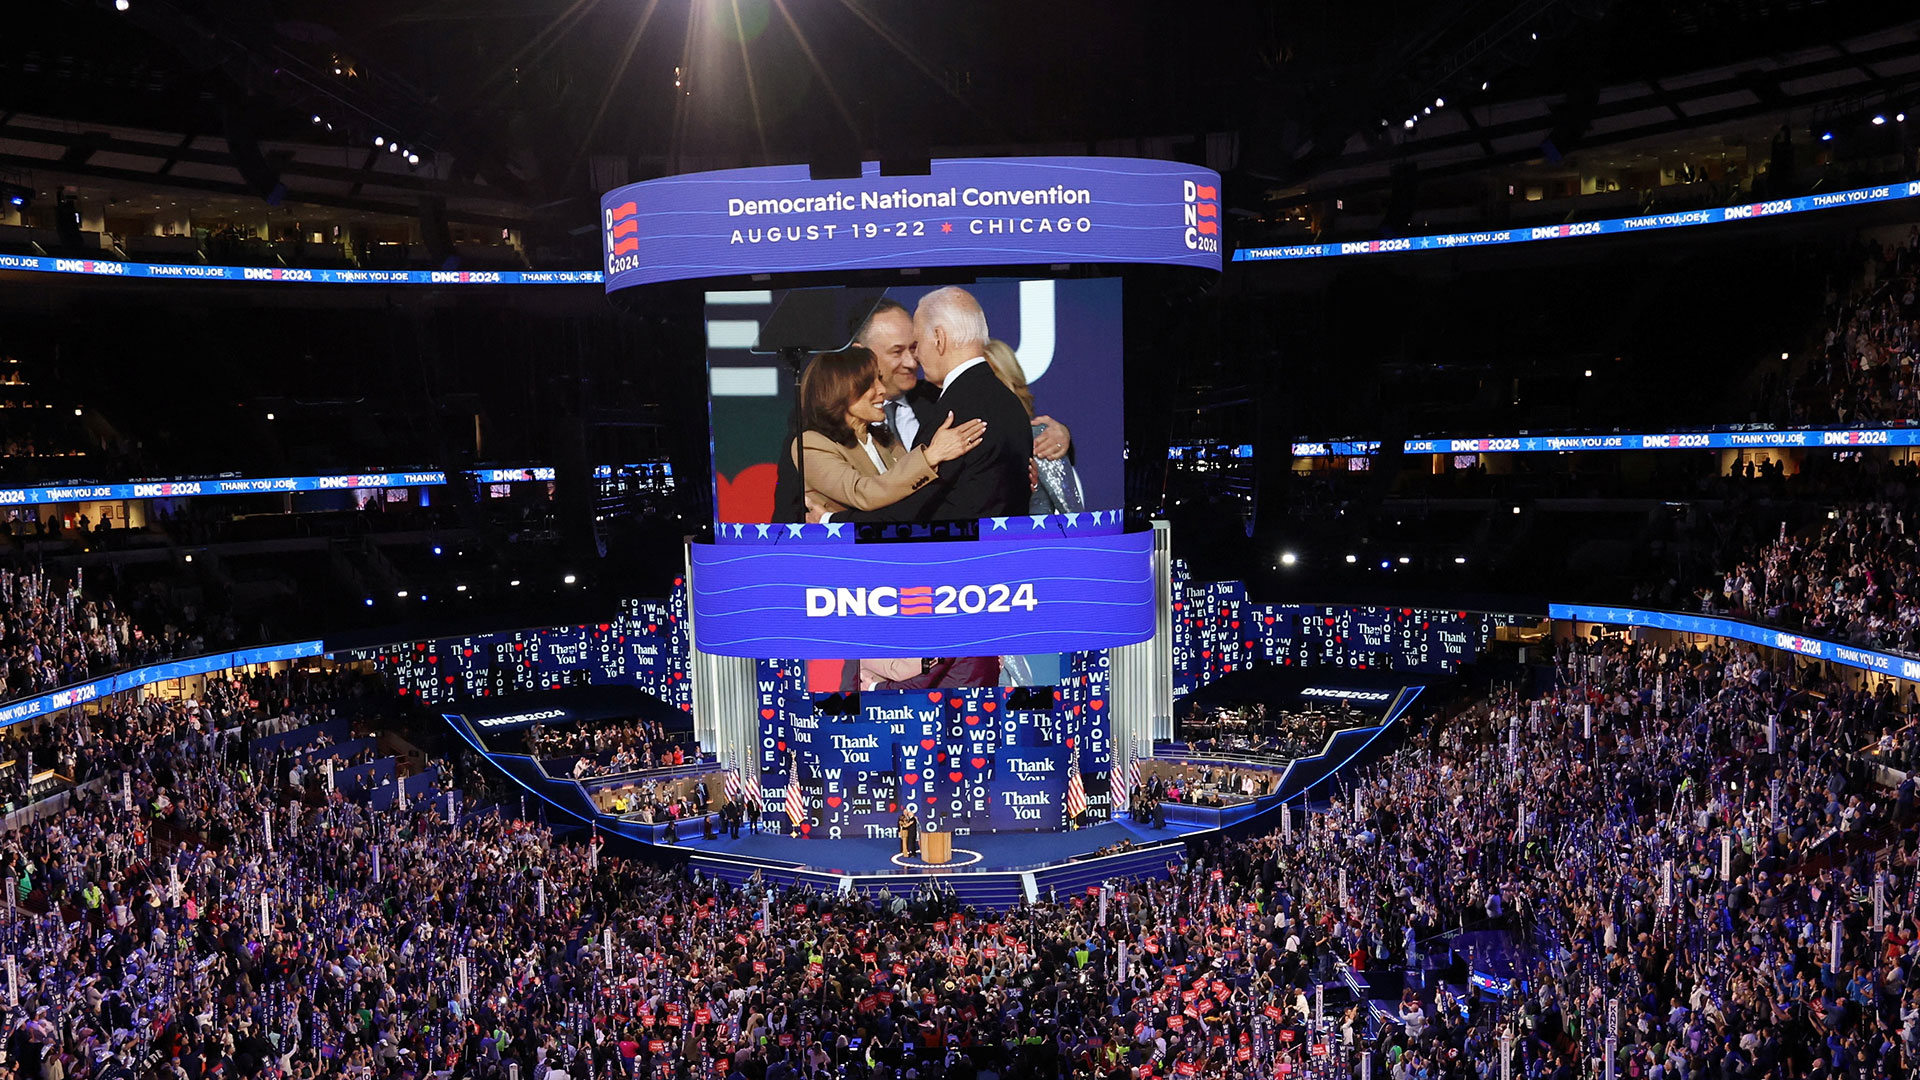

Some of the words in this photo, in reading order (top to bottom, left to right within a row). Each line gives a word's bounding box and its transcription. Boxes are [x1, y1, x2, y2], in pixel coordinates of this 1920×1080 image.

[729, 192, 854, 216] Democratic
[862, 188, 956, 209] National
[963, 185, 1089, 206] Convention
[1813, 194, 1845, 205] THANK
[1848, 191, 1868, 201] YOU
[1870, 188, 1888, 198] JOE
[1761, 200, 1792, 215] 2024
[1184, 180, 1197, 250] DNC
[1624, 218, 1657, 228] THANK
[1659, 215, 1681, 224] YOU
[1678, 213, 1702, 224] JOE
[731, 225, 836, 244] AUGUST
[852, 221, 924, 238] 19-22
[970, 218, 1090, 234] CHICAGO
[1567, 223, 1600, 235] 2024
[606, 208, 615, 275] DNC
[1198, 236, 1218, 253] 2024
[1377, 239, 1410, 251] 2024
[1437, 235, 1468, 246] THANK
[1471, 234, 1490, 242] YOU
[1492, 232, 1510, 241] JOE
[1251, 249, 1282, 257] THANK
[21, 259, 38, 267] JOE
[91, 262, 123, 274] 2024
[615, 255, 639, 272] 2024
[280, 270, 312, 280] 2024
[336, 271, 367, 282] THANK
[469, 272, 500, 282] 2024
[1488, 439, 1520, 450] 2024
[1547, 438, 1579, 449] THANK
[1603, 438, 1621, 446] JOE
[1677, 435, 1709, 446] 2024
[1732, 435, 1763, 443] THANK
[1766, 434, 1789, 443] YOU
[1787, 435, 1802, 443] JOE
[1857, 432, 1887, 443] 2024
[1413, 442, 1432, 450] JOE
[221, 482, 249, 490] THANK
[251, 481, 277, 490] YOU
[278, 480, 292, 489] JOE
[355, 475, 388, 486] 2024
[404, 474, 436, 482] THANK
[46, 488, 73, 501] THANK
[74, 489, 91, 497] YOU
[93, 488, 111, 496] JOE
[169, 483, 201, 495] 2024
[1173, 582, 1182, 600] WE
[1217, 584, 1232, 594] You
[806, 587, 897, 616] DNC
[935, 584, 1038, 614] 2024
[1364, 633, 1380, 645] You
[1438, 631, 1466, 645] Thank
[579, 632, 587, 659] JOE
[601, 635, 609, 661] JOE
[632, 644, 658, 654] Thank
[1444, 642, 1461, 653] You
[1801, 638, 1821, 656] 2024
[556, 655, 576, 664] You
[638, 655, 653, 665] You
[1836, 648, 1859, 663] THANK
[1860, 652, 1874, 666] YOU
[1874, 658, 1888, 669] JOE
[1088, 672, 1103, 696] WE
[759, 681, 774, 704] WE
[1346, 690, 1390, 700] 2024
[13, 704, 26, 716] YOU
[28, 702, 40, 712] JOE
[526, 710, 565, 720] 2024
[866, 706, 913, 720] Thank
[789, 713, 819, 728] Thank
[919, 711, 934, 735] WE
[794, 728, 811, 742] You
[987, 717, 995, 753] JOE
[1005, 711, 1016, 745] JOE
[1091, 715, 1102, 752] JOE
[764, 724, 774, 761] JOE
[831, 734, 878, 748] Thank
[970, 730, 985, 753] WE
[841, 750, 869, 762] You
[902, 746, 918, 769] WE
[947, 745, 963, 768] WE
[1007, 758, 1054, 772] Thank
[825, 769, 841, 792] WE
[923, 755, 934, 792] JOE
[973, 773, 984, 810] JOE
[1002, 791, 1049, 805] Thank
[1012, 806, 1040, 819] You
